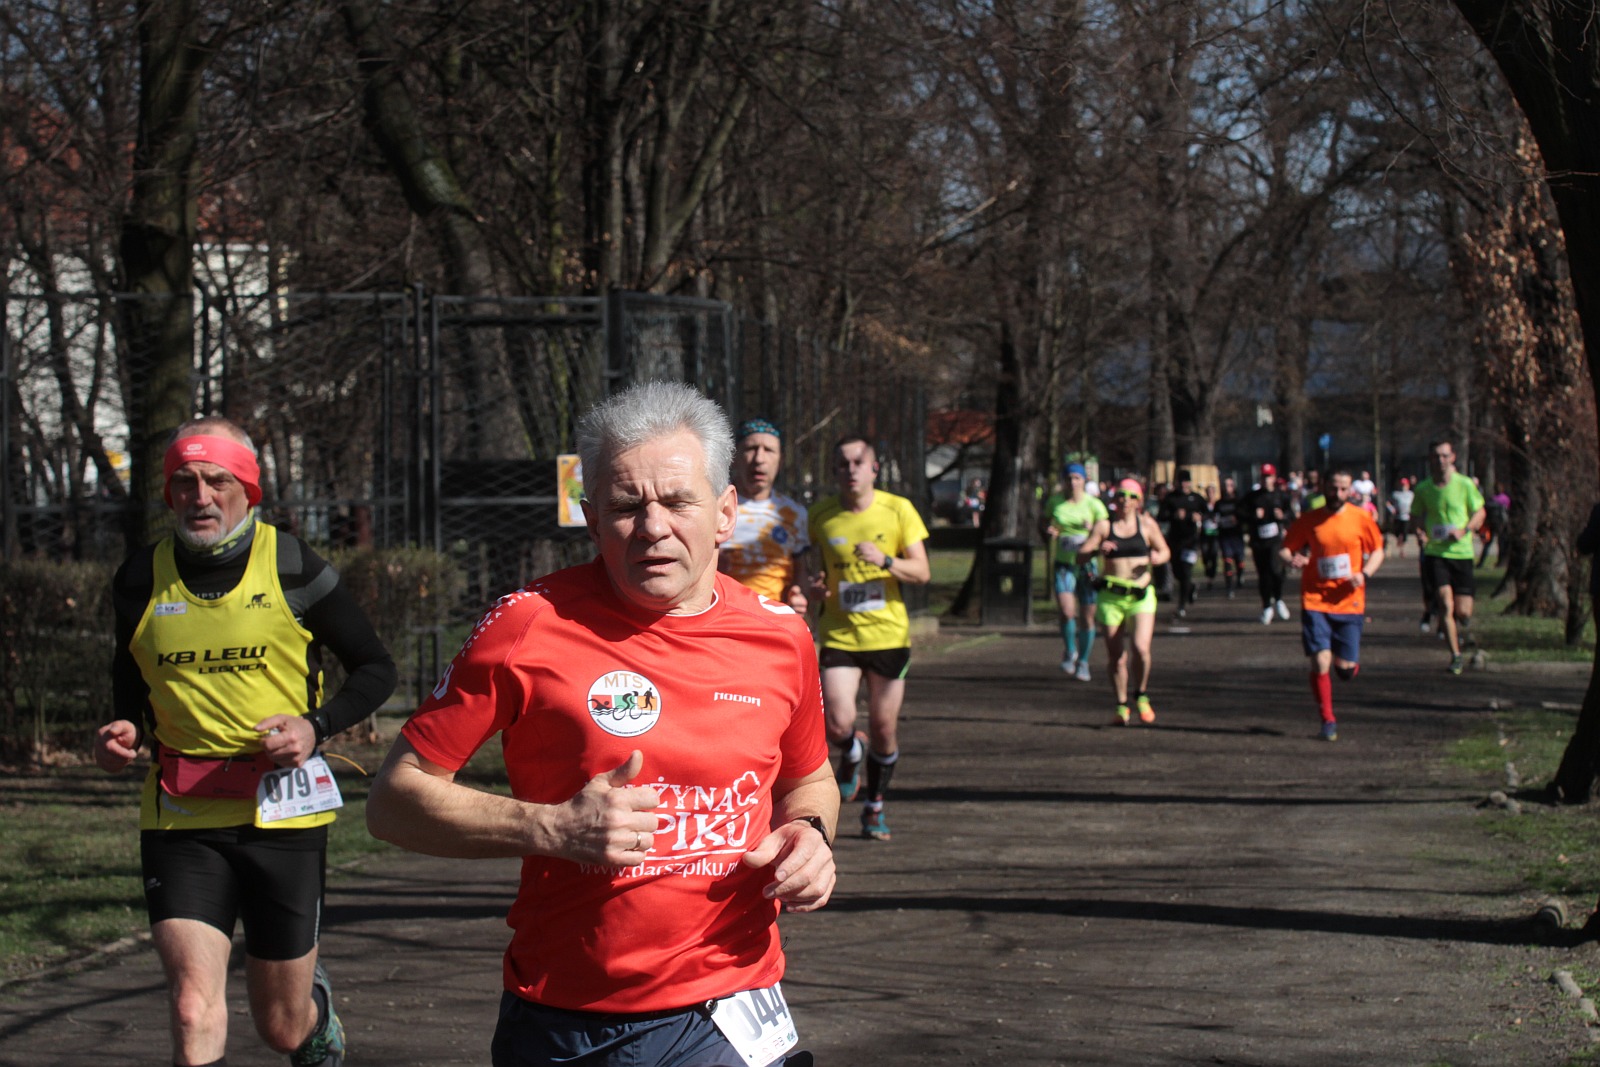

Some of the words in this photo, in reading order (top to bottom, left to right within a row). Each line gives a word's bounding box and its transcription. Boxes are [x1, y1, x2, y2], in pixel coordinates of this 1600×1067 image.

[158, 651, 196, 667] KB
[203, 646, 267, 662] LEW
[199, 663, 267, 674] LEGNICA
[604, 673, 643, 689] MTS
[264, 768, 311, 803] 079
